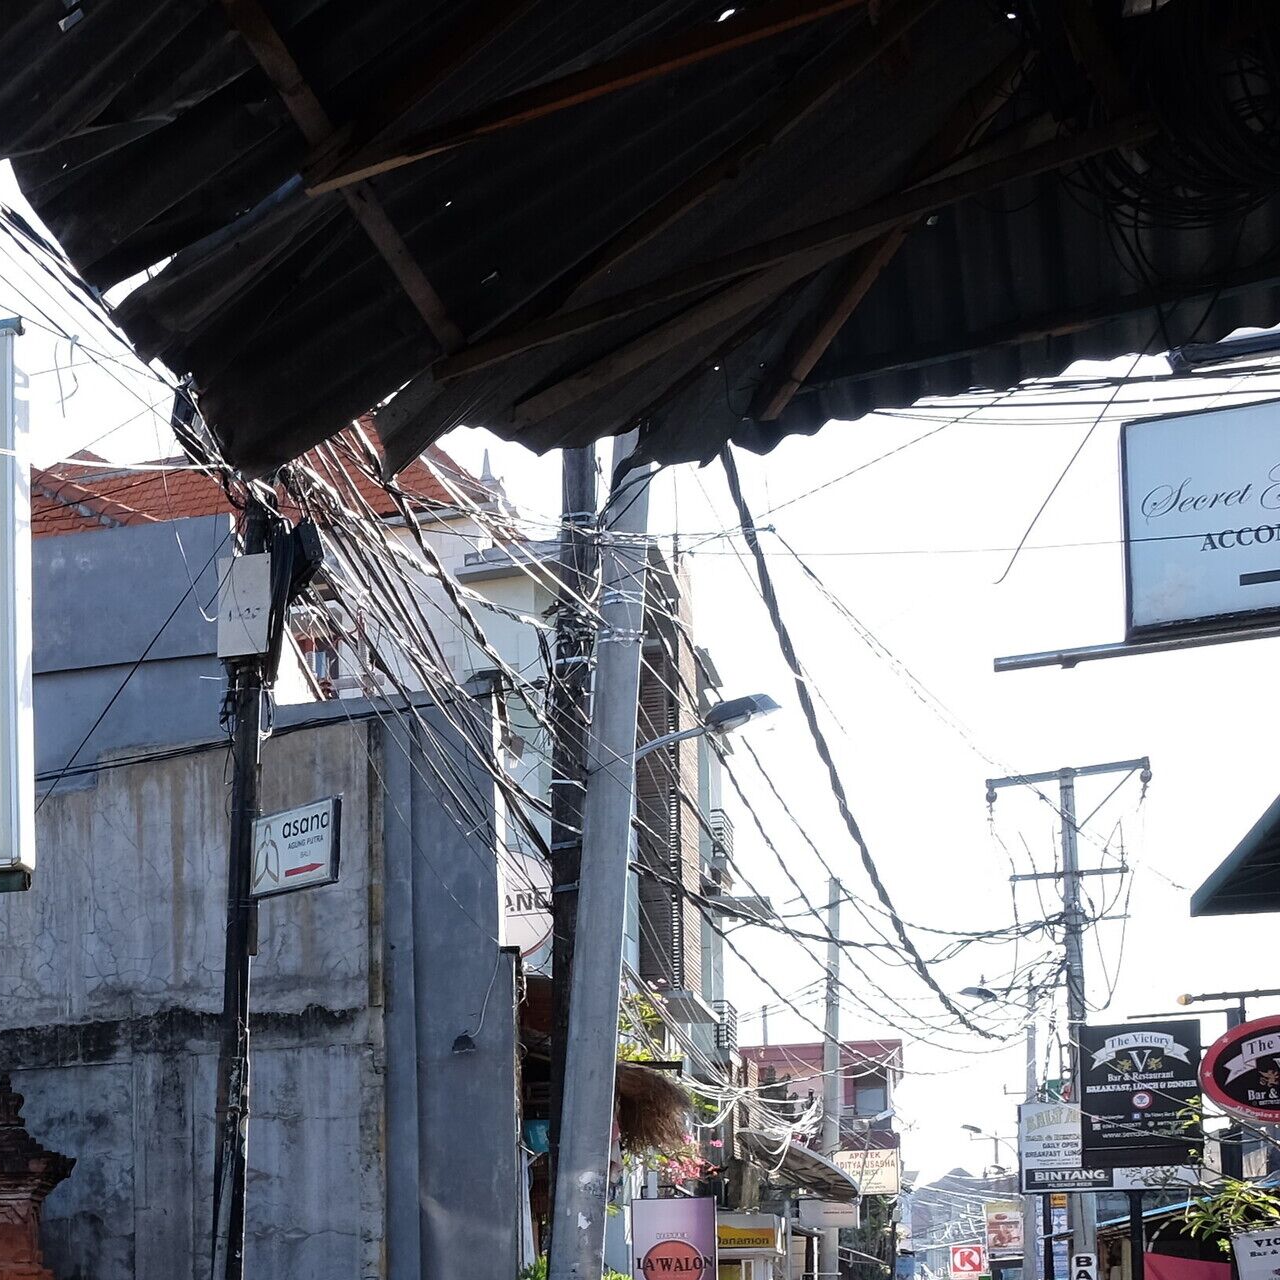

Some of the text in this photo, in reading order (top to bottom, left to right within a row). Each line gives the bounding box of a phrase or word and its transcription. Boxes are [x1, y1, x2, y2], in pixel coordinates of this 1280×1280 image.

[1141, 477, 1252, 526] Secret
[287, 834, 324, 850] AGUNG PUTRA
[1110, 1034, 1171, 1049] The Victory
[1247, 1039, 1274, 1055] The
[1107, 1073, 1122, 1082] Bar
[1132, 1071, 1174, 1081] Restaurant
[1133, 1081, 1158, 1091] LUNCH
[1167, 1079, 1198, 1089] DINNER
[1247, 1088, 1279, 1100] Bar &
[1025, 1150, 1061, 1158] BREAKFAST
[1034, 1169, 1105, 1181] BINTANG
[636, 1254, 714, 1272] LA'WALON
